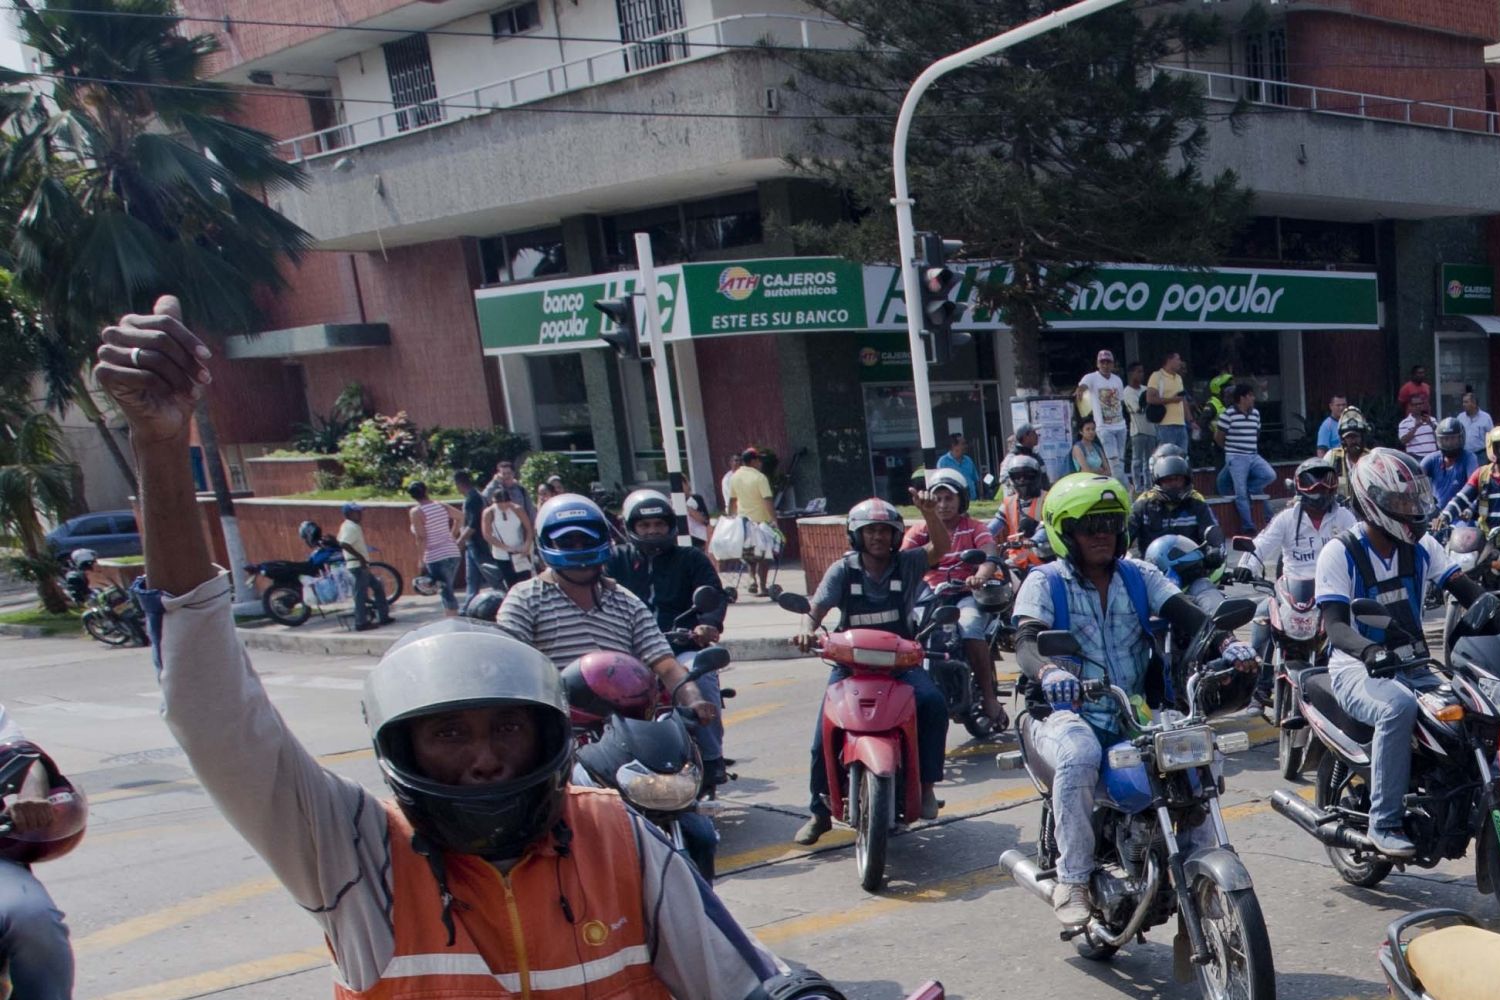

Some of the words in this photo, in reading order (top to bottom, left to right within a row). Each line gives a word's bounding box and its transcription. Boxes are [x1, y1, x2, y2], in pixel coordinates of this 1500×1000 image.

[717, 273, 760, 293] ATH
[762, 272, 837, 287] CAJEROS
[763, 285, 838, 298] automáticos
[1156, 273, 1285, 322] popular
[543, 290, 584, 314] banco
[539, 312, 589, 344] popular
[712, 315, 747, 329] ESTE
[751, 313, 768, 327] ES
[772, 312, 790, 325] SU
[796, 309, 849, 325] BANCO
